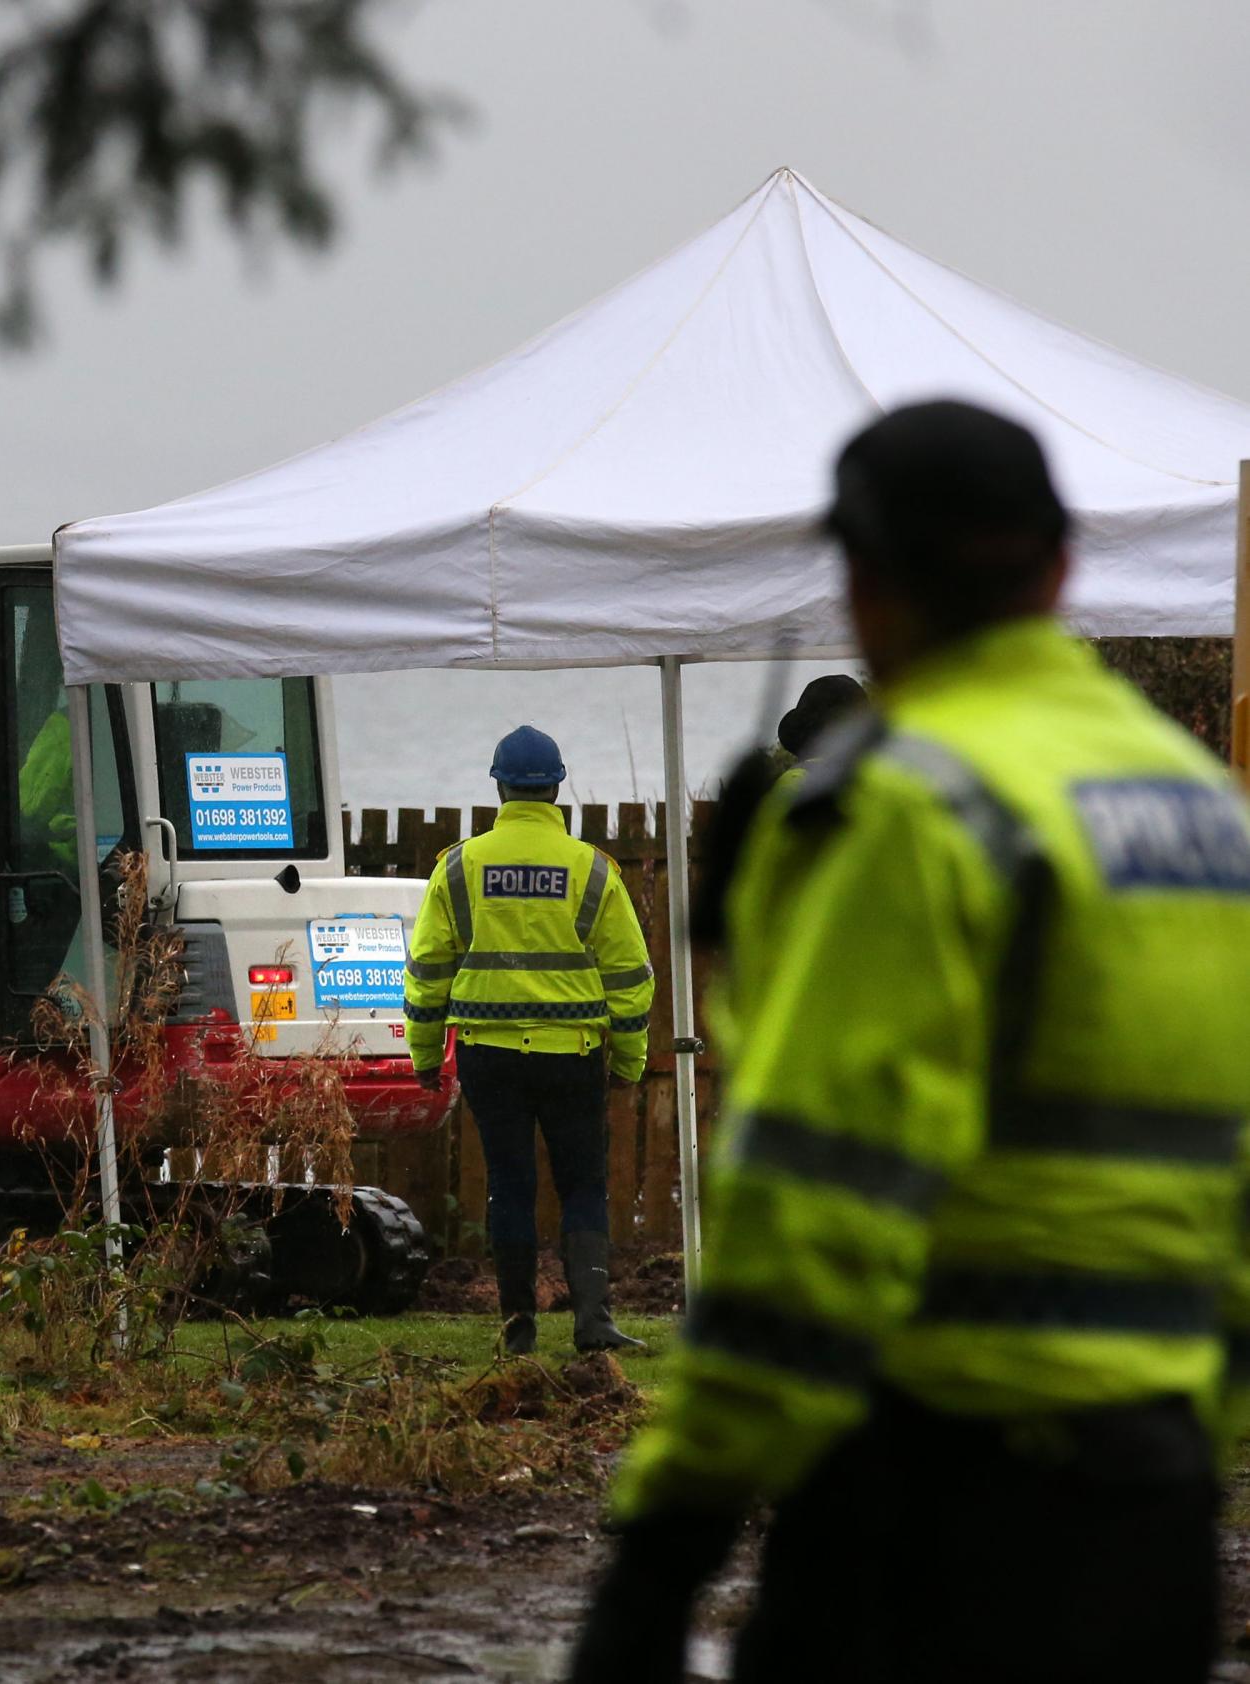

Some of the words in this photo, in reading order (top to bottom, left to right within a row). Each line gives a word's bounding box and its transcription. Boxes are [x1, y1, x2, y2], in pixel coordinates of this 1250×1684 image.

[194, 773, 225, 782] WEBSTER
[230, 767, 281, 780] WEBSTER
[232, 783, 252, 792] Power
[254, 783, 282, 792] Products
[196, 808, 236, 826] 01698
[239, 808, 287, 826] 381392
[197, 832, 289, 843] www.websterpowertools.com
[487, 869, 564, 893] POLICE
[355, 927, 400, 940] WEBSTER
[358, 943, 377, 952] Power
[379, 943, 402, 952] Products
[318, 969, 362, 987] 01698
